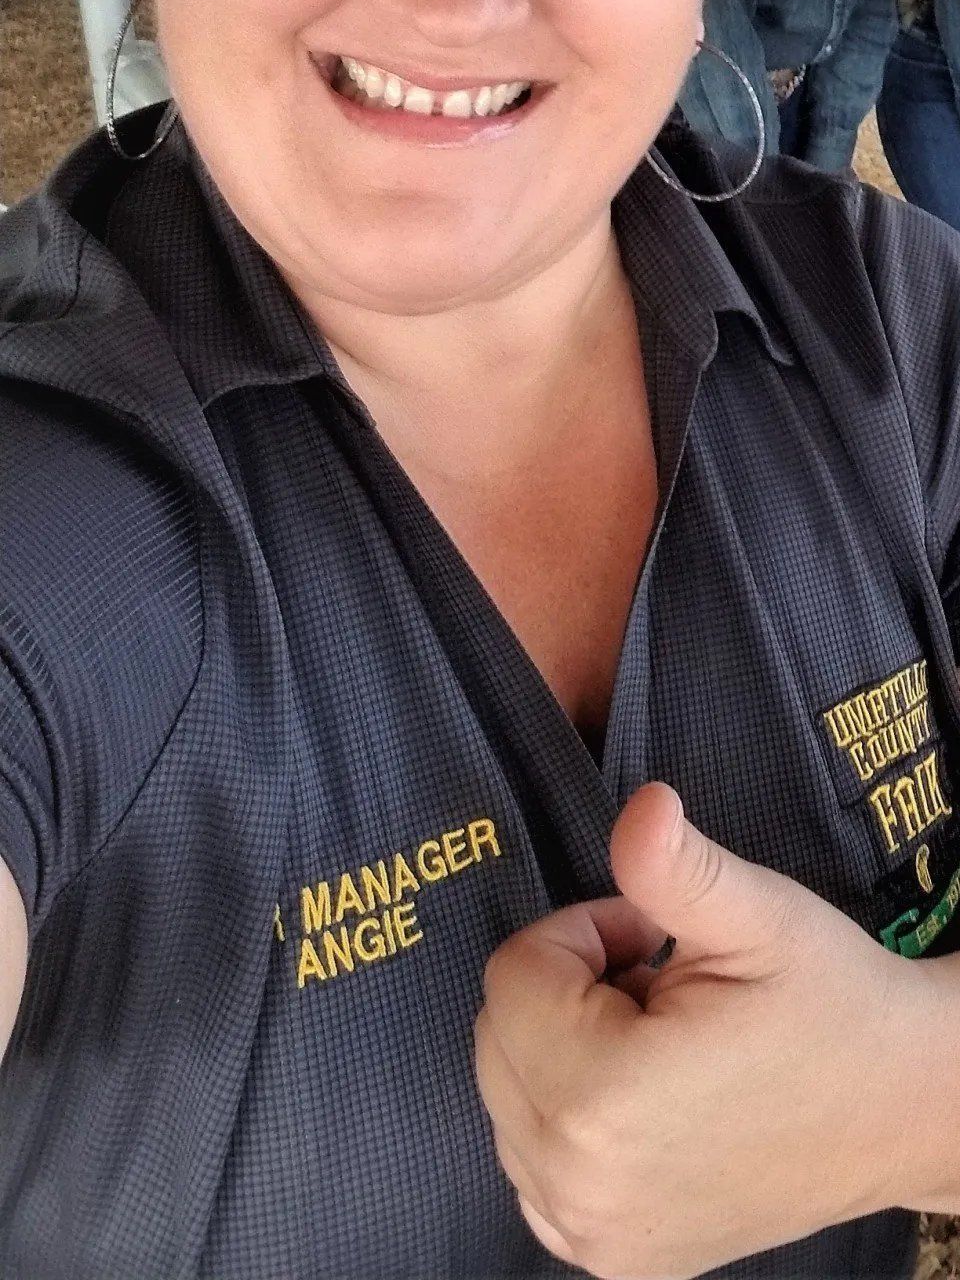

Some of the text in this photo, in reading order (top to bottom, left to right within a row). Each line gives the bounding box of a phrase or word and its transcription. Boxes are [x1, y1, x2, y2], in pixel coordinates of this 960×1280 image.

[823, 658, 929, 749] UMATILLA
[849, 700, 931, 781] COUNTY
[869, 750, 952, 854] FAIR
[302, 818, 501, 935] MANAGER
[298, 901, 424, 988] ANGIE
